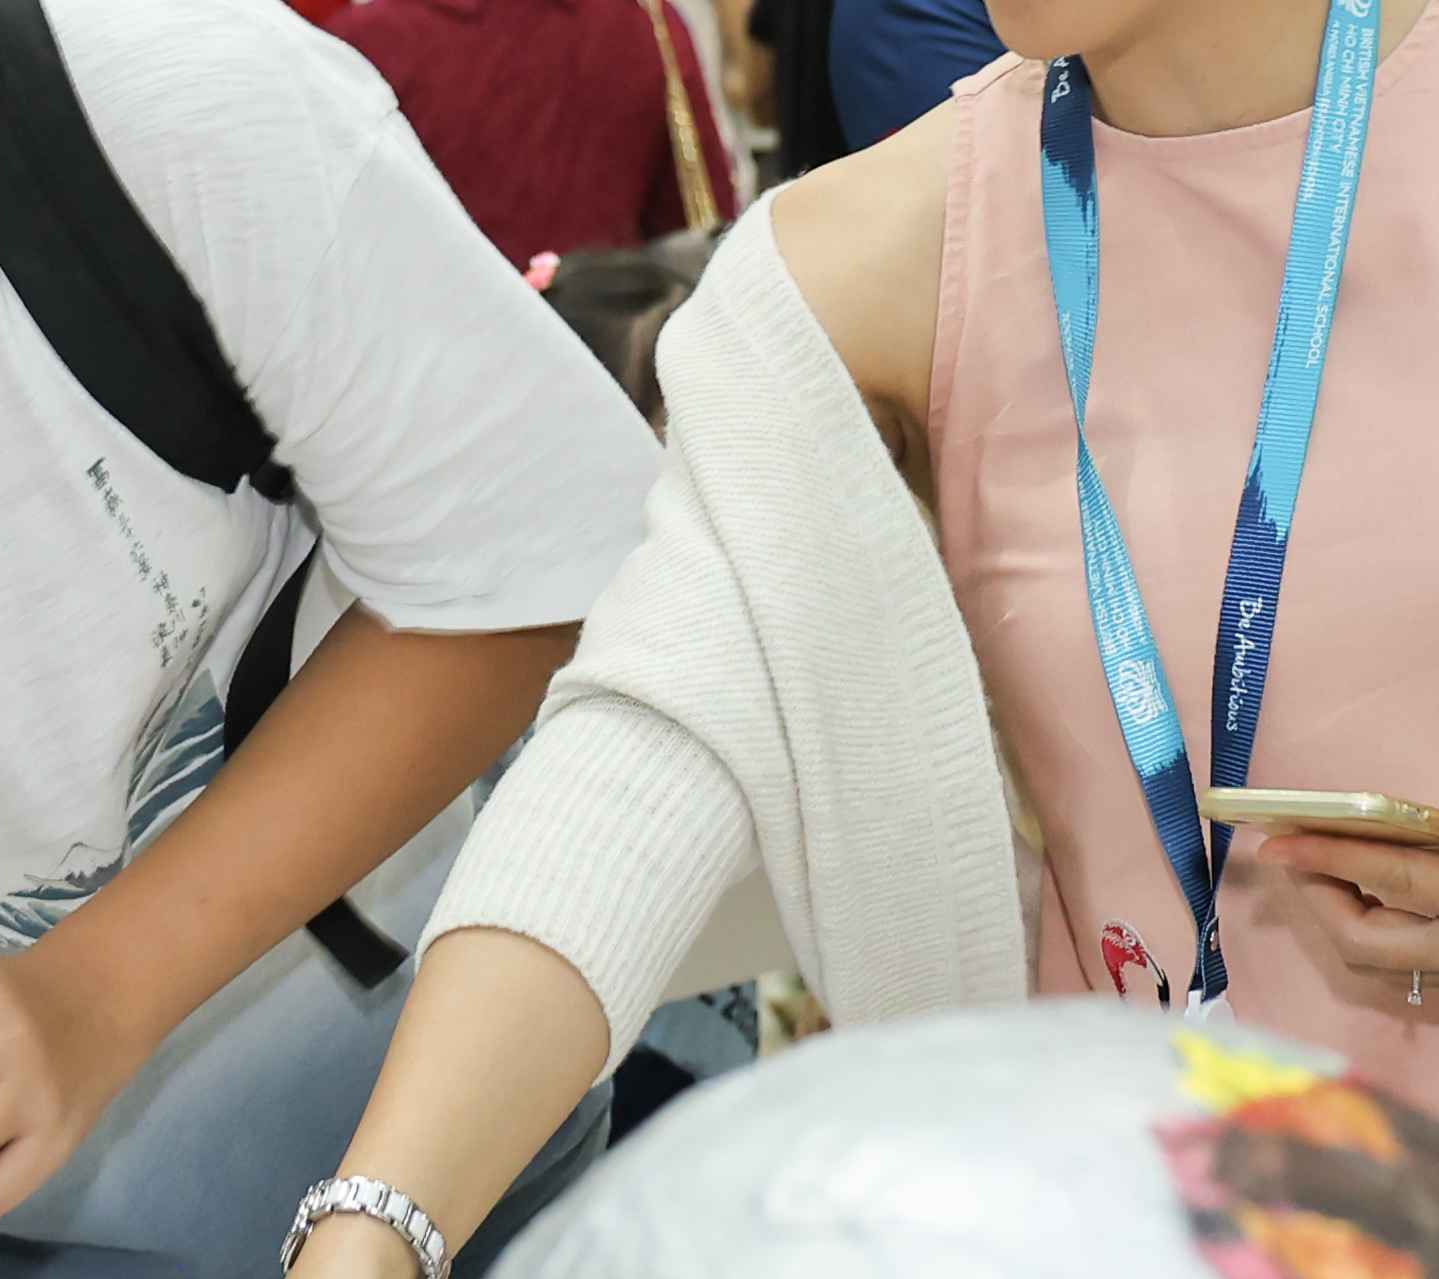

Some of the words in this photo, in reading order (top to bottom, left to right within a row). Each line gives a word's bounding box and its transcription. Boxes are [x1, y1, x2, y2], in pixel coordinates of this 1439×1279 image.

[1344, 23, 1359, 48] HO
[1358, 27, 1375, 80] BRITISH
[1341, 49, 1356, 74] CHI
[1050, 69, 1073, 105] Be
[1336, 76, 1353, 116] MINH
[1330, 118, 1346, 154] CITY
[1341, 79, 1369, 177] VIETNAMESE
[1319, 181, 1352, 299] INTERNATIONAL
[1306, 305, 1329, 369] SCHOOL
[1237, 597, 1264, 631] Be
[1225, 632, 1257, 732] Ambitious
